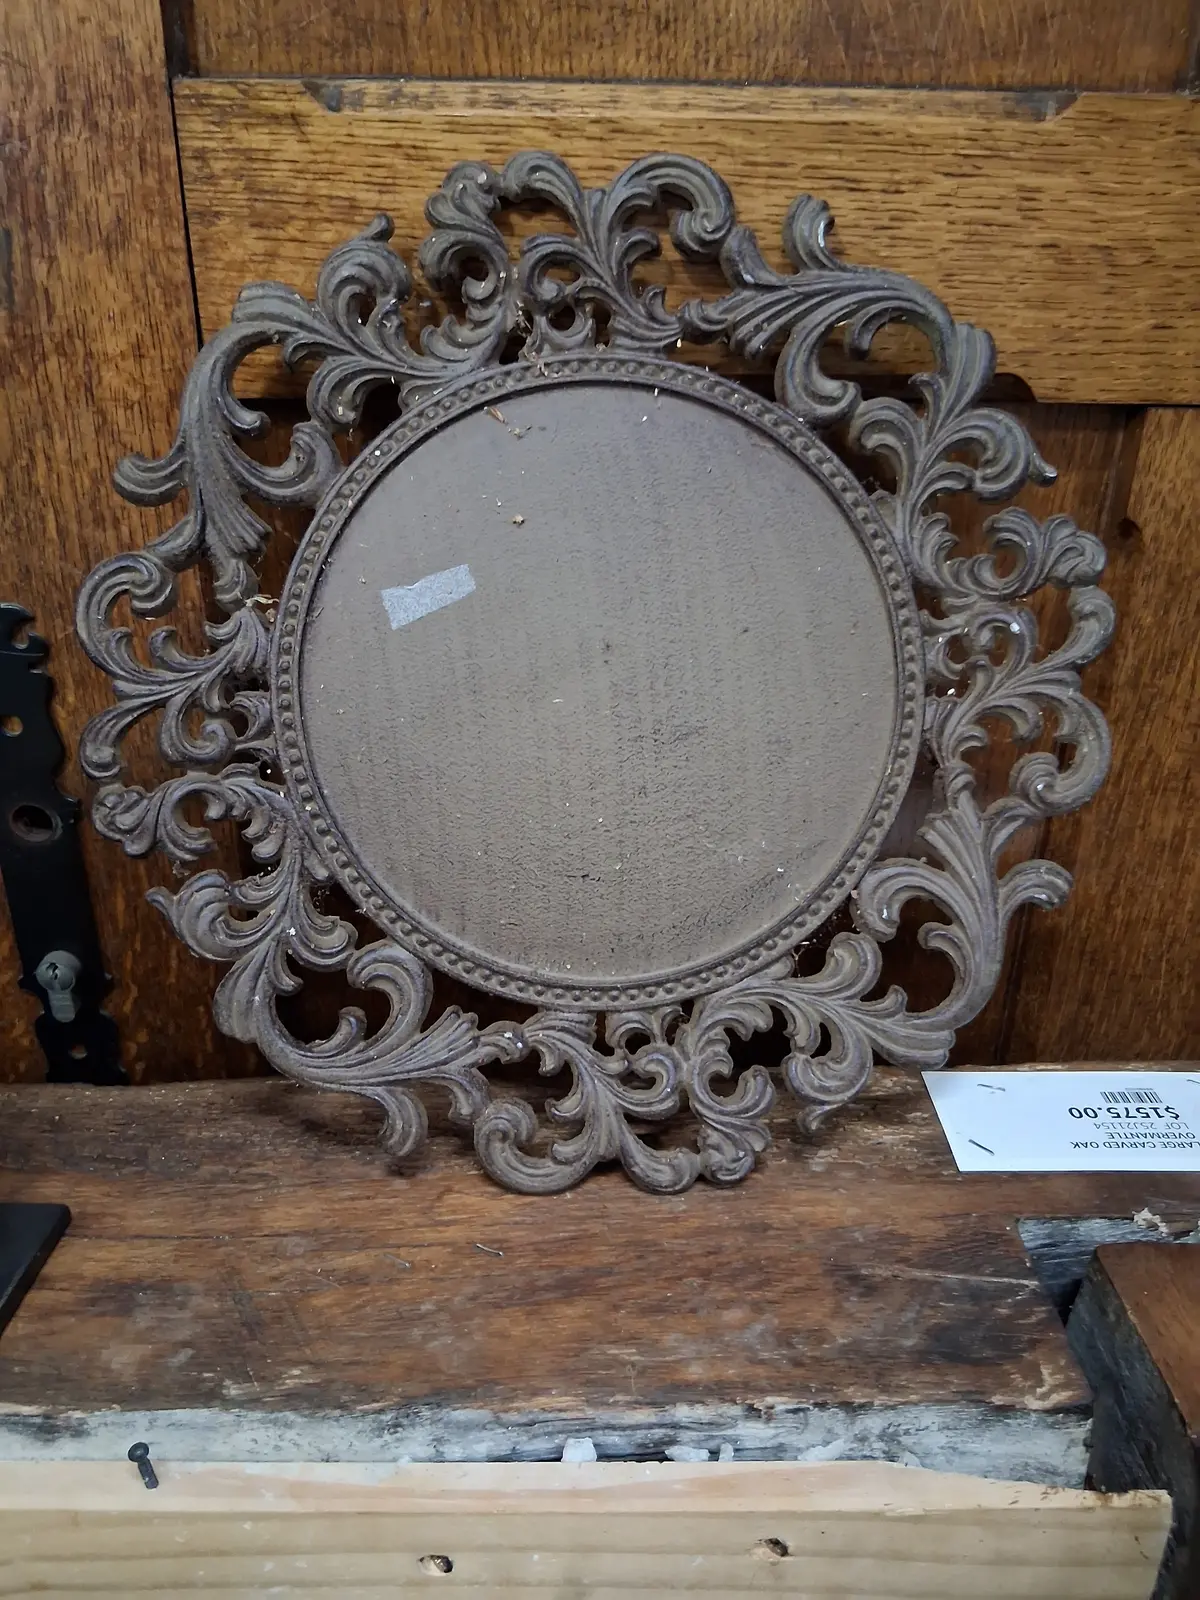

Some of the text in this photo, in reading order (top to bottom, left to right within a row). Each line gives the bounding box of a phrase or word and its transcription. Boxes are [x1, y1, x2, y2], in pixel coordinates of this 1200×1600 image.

[1068, 1105, 1180, 1120] $1575.00
[1105, 1131, 1196, 1139] OVERMANTLE
[1070, 1141, 1099, 1149] OAK
[1103, 1141, 1156, 1149] CARVED
